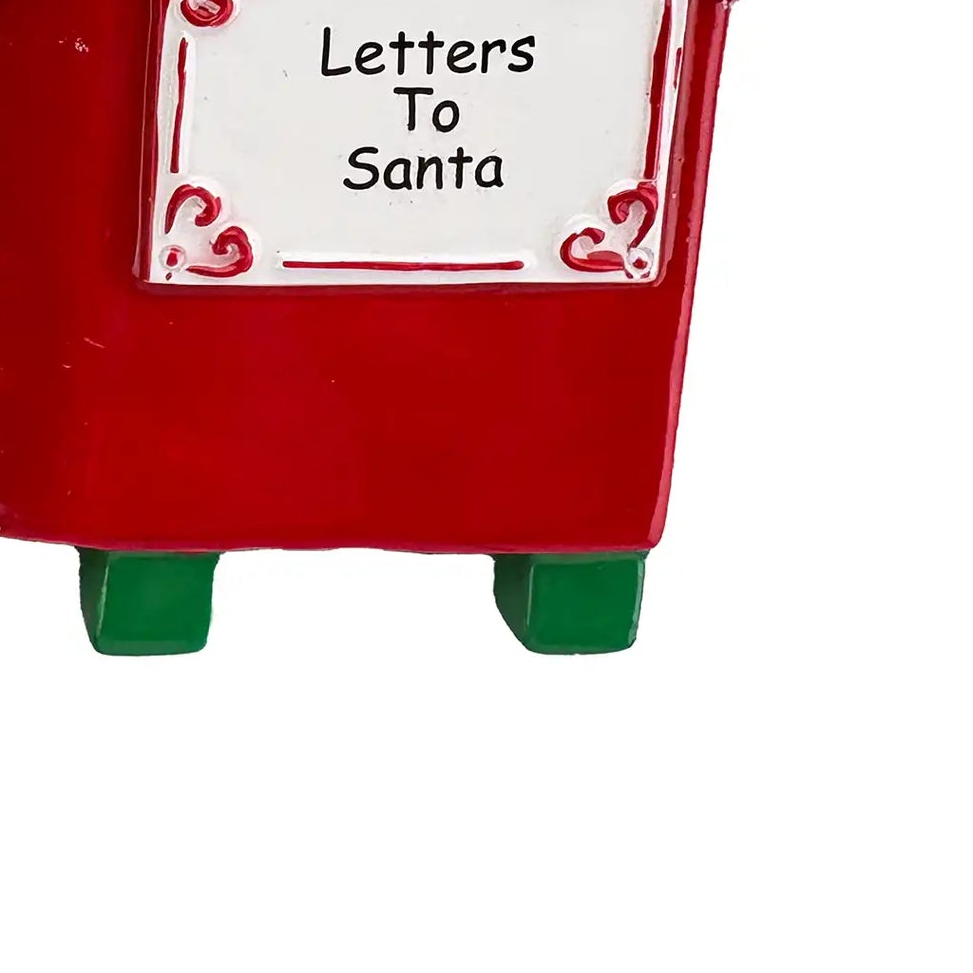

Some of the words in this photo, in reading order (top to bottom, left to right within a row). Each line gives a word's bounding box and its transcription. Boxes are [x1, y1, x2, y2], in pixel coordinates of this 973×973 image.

[321, 26, 536, 76] Letters
[393, 86, 460, 132] To
[342, 146, 504, 190] Santa
